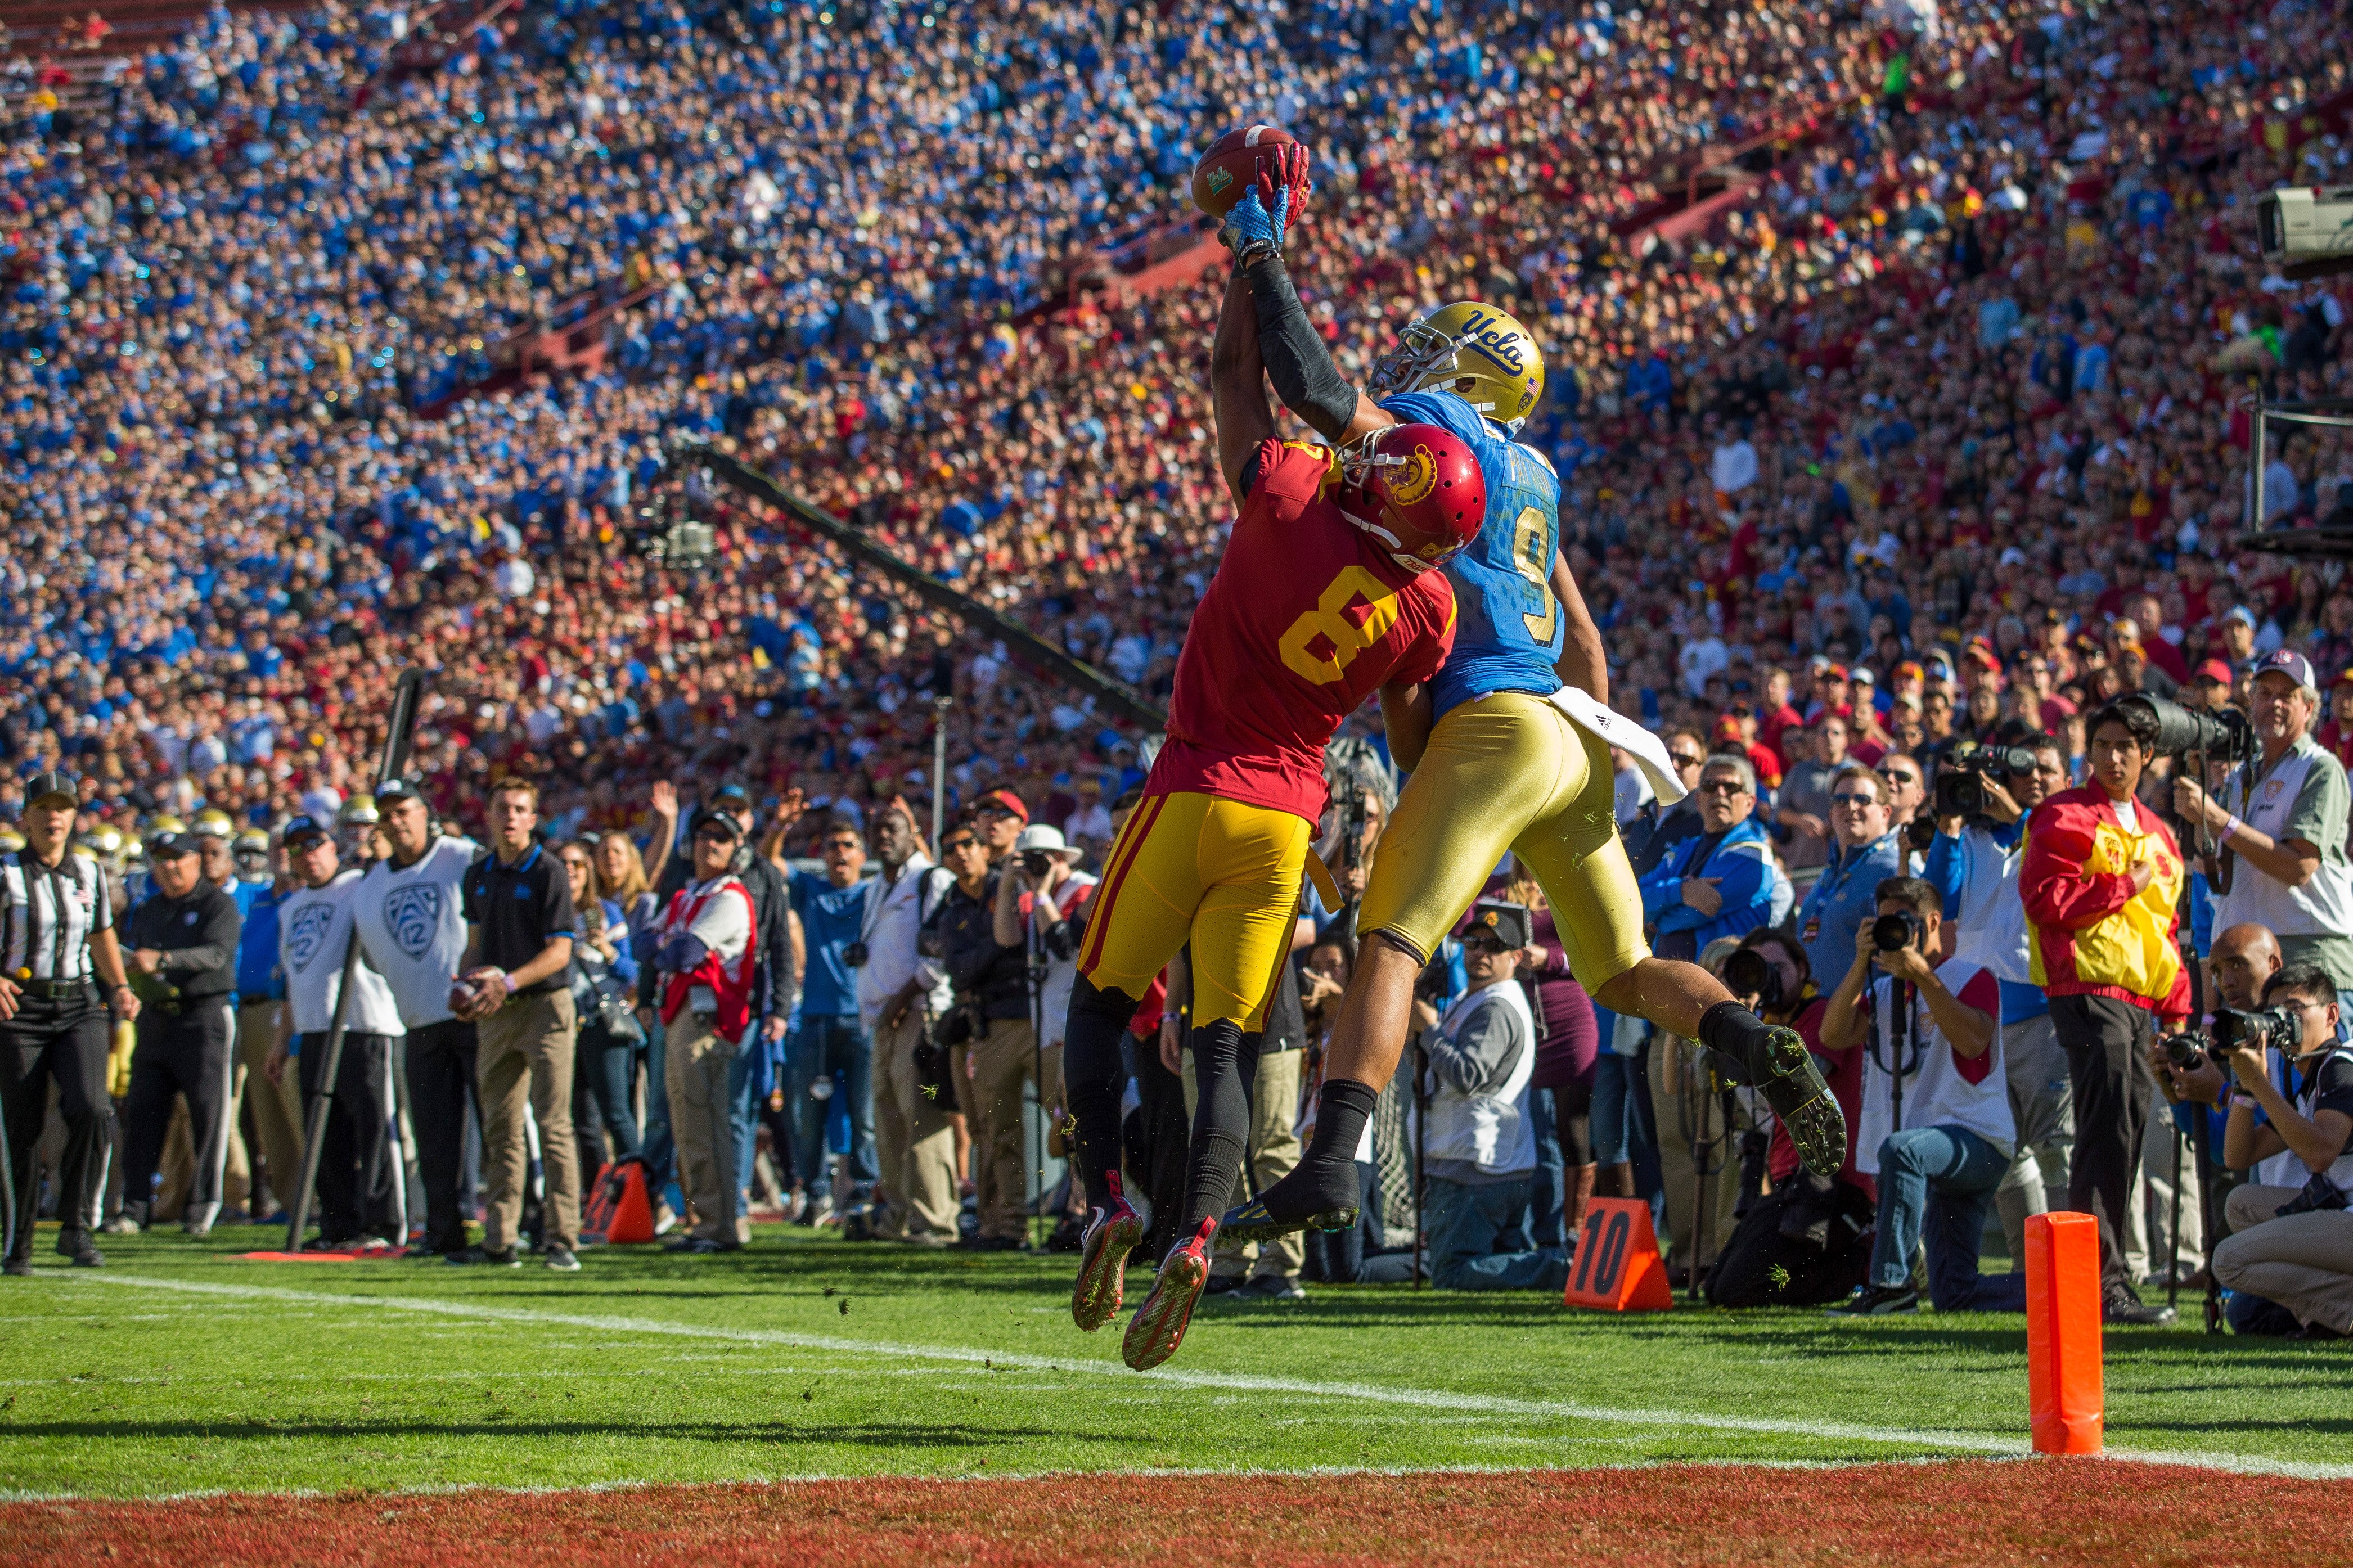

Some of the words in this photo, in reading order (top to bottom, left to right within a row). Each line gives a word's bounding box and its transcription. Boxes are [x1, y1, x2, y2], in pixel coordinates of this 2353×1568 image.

[1241, 241, 1264, 257] adizero
[1513, 505, 1556, 648] 9
[1279, 566, 1397, 686] 8
[403, 924, 424, 945] 12
[1576, 1209, 1630, 1296] 10
